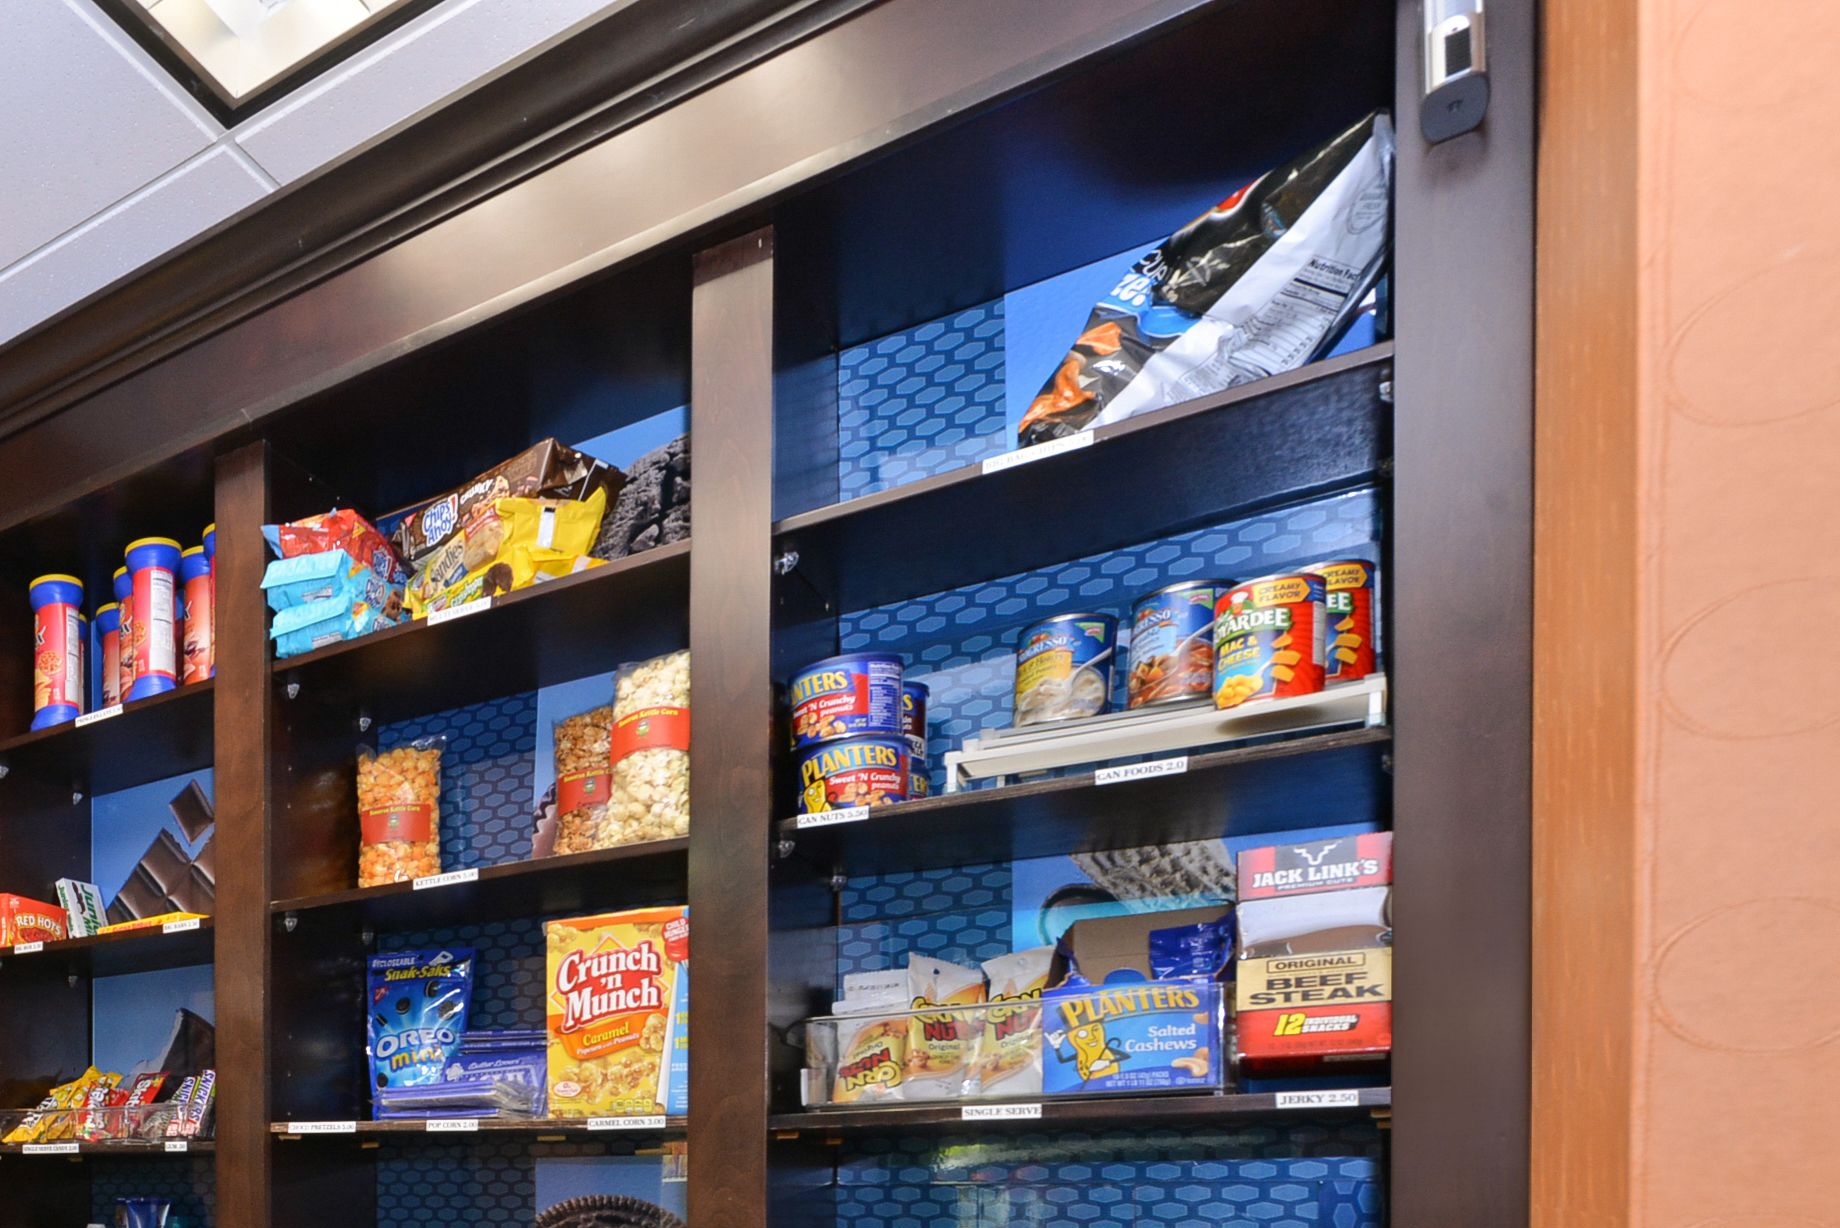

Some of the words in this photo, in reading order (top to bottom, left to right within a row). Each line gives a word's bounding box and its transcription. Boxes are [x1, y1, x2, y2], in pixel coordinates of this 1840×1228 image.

[461, 479, 493, 504] CHUNKY
[424, 503, 449, 532] Chips
[1259, 581, 1301, 596] CREAMY
[1259, 589, 1302, 604] FLAVOR
[1221, 637, 1244, 657] MAC
[1247, 635, 1257, 647] &
[1218, 650, 1260, 670] CHEESE
[819, 695, 856, 709] Crunchy
[639, 710, 661, 719] Kettle
[820, 705, 853, 717] peanuts
[802, 745, 897, 786] PLANTERS
[1096, 769, 1121, 781] CAN
[1124, 764, 1164, 778] FOODS
[829, 775, 855, 785] Sweet
[870, 772, 901, 784] Crunchy
[872, 782, 900, 790] peanuts
[798, 816, 818, 825] CAN
[820, 812, 845, 822] NUTS
[416, 877, 441, 887] KETTLE
[443, 874, 461, 884] CORN
[1252, 866, 1302, 888] JACK
[1310, 859, 1379, 882] LINK'S
[1278, 881, 1323, 890] PREMIUM
[16, 915, 35, 926] RED
[38, 917, 62, 936] HOTS
[559, 943, 659, 992] Crunch
[1274, 956, 1356, 970] ORIGINAL
[385, 964, 451, 982] Snak-Saks
[1266, 971, 1368, 991] BEEF
[601, 974, 623, 989] 'n
[565, 977, 659, 1028] Munch
[1249, 983, 1386, 1006] STEAK
[1061, 985, 1200, 1028] PLANTERS
[1148, 1024, 1196, 1037] Salted
[1274, 1013, 1306, 1036] 12
[1302, 1022, 1350, 1033] SNACKS
[583, 1022, 629, 1046] Caramel
[377, 1029, 454, 1058] OREO
[577, 1042, 602, 1055] Popcorn
[613, 1033, 640, 1046] Peanuts
[929, 1042, 960, 1051] Original
[1125, 1038, 1197, 1052] Cashews
[845, 1061, 902, 1092] CORN
[1280, 1094, 1324, 1106] JERKY
[1328, 1092, 1357, 1104] 2.50
[964, 1108, 1003, 1117] SINGLE
[1005, 1107, 1040, 1116] SERVE
[589, 1119, 621, 1128] CARMEL
[623, 1119, 646, 1127] CORN
[647, 1118, 664, 1126] 3.00
